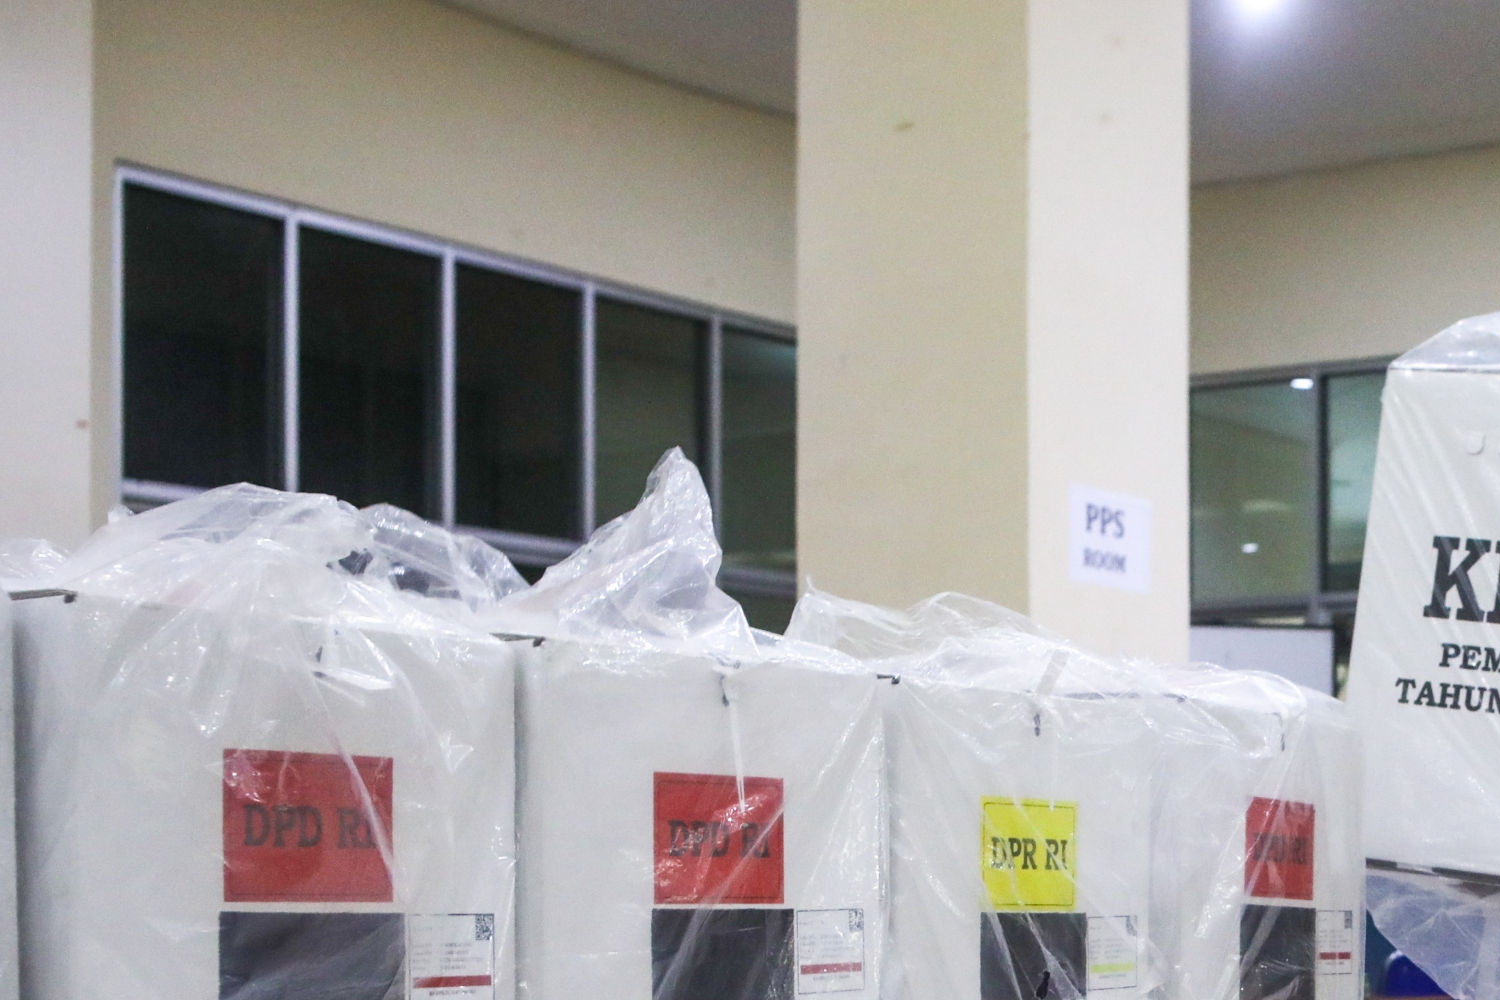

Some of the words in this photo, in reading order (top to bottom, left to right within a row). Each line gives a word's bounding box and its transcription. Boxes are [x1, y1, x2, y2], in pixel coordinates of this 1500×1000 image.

[1085, 502, 1125, 539] PPS
[243, 803, 323, 848] DPD
[668, 818, 729, 857] DPD
[991, 836, 1038, 870] DPR
[1044, 838, 1068, 871] RI
